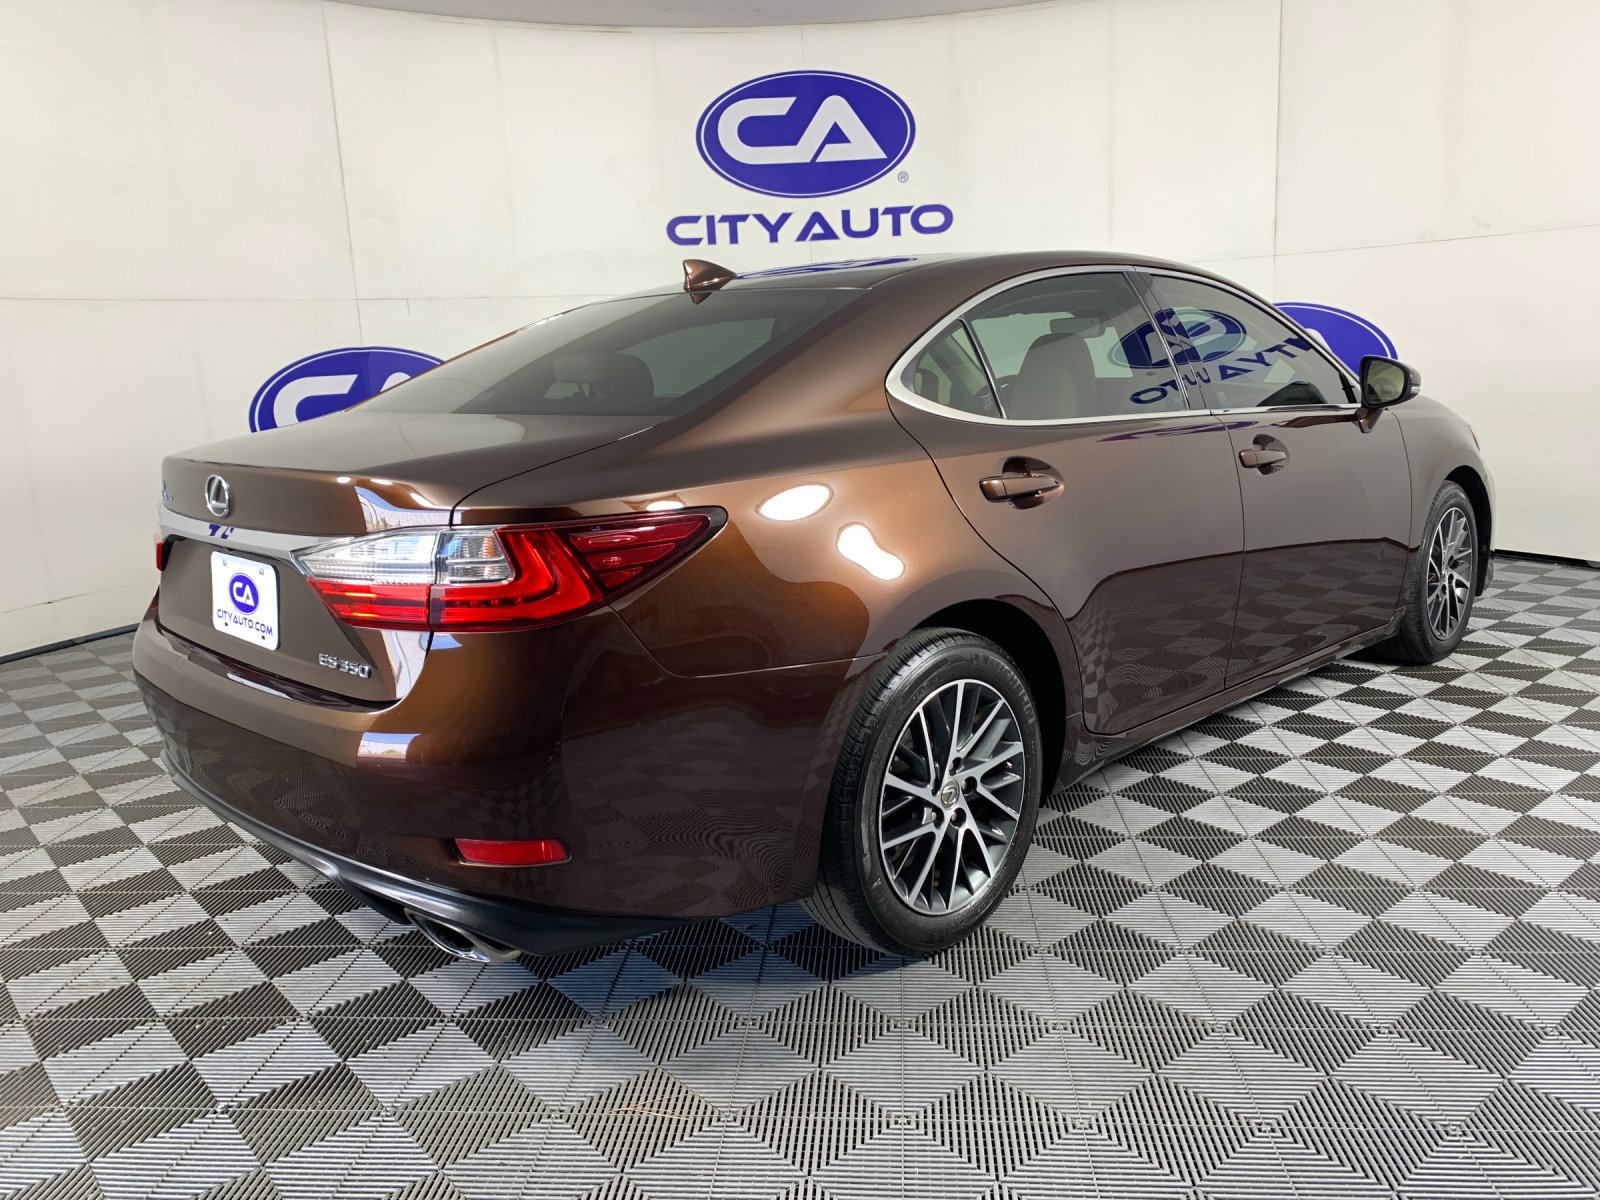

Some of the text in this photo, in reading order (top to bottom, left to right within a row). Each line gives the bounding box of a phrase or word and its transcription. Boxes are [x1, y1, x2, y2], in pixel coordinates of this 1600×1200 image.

[717, 95, 888, 165] CA
[232, 581, 256, 607] CA
[318, 652, 371, 679] ES 350
